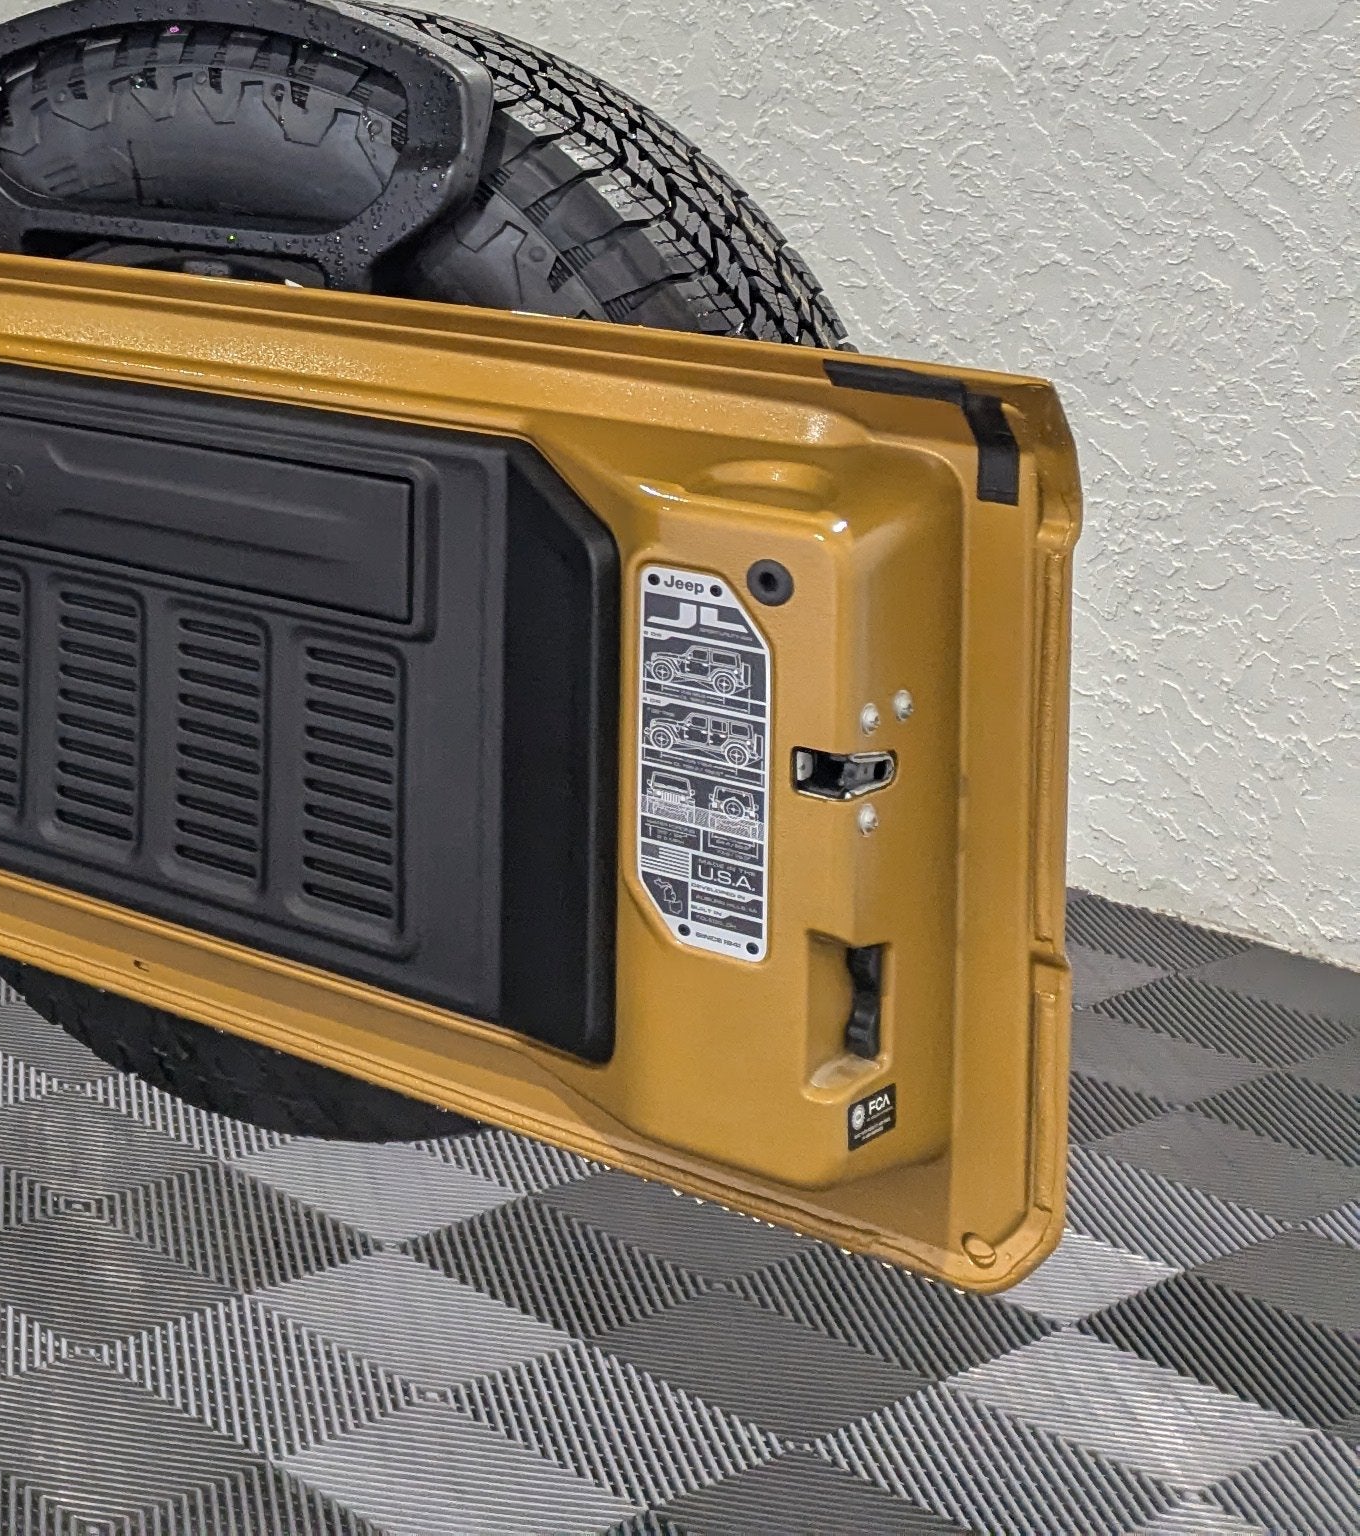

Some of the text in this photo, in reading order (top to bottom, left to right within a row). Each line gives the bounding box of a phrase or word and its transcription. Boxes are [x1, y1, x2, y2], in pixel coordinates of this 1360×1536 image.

[663, 575, 705, 596] Jeep
[646, 601, 749, 634] JL
[698, 864, 756, 892] U.S.A.
[868, 1093, 891, 1116] FCA
